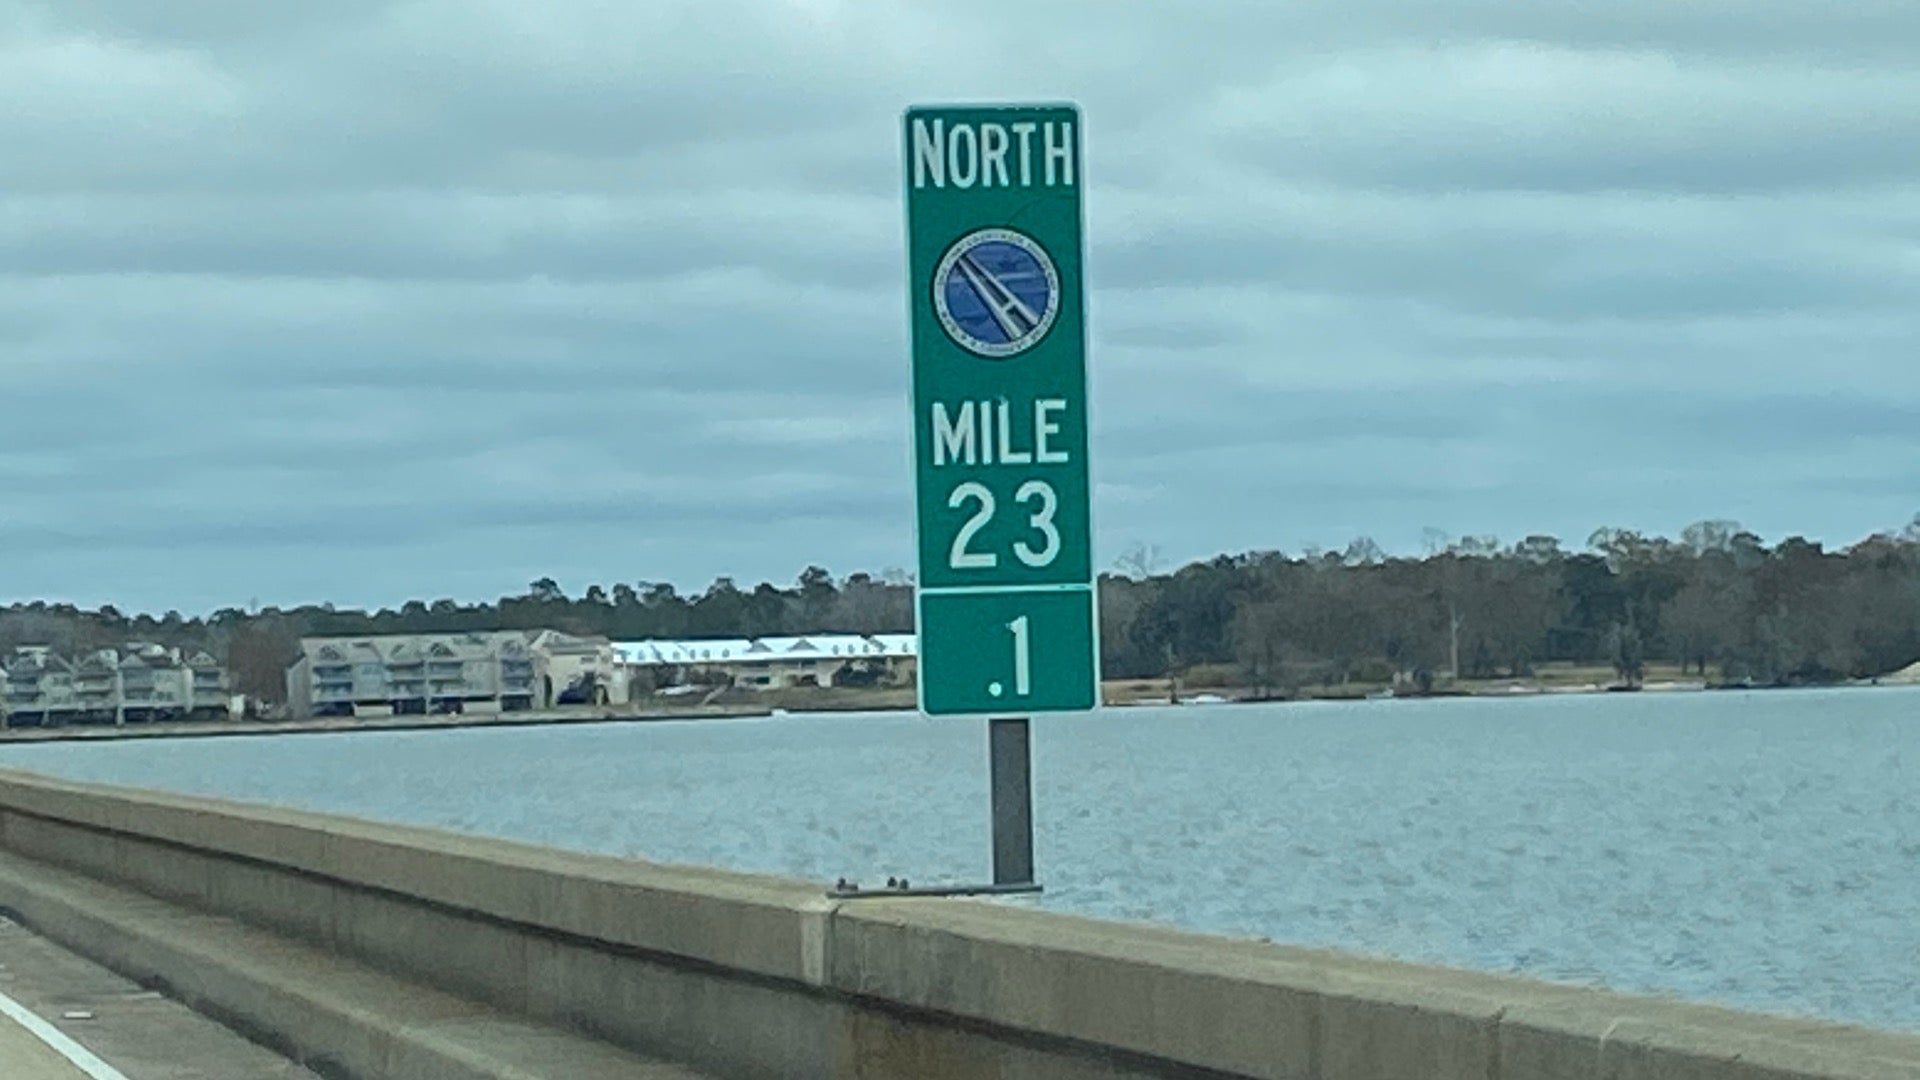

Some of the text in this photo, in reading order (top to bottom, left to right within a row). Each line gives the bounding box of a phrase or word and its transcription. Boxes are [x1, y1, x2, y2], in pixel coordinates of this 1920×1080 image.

[913, 118, 1074, 188] NORTH
[932, 398, 1068, 467] MILE
[949, 481, 1060, 570] 23
[988, 615, 1031, 696] .1
